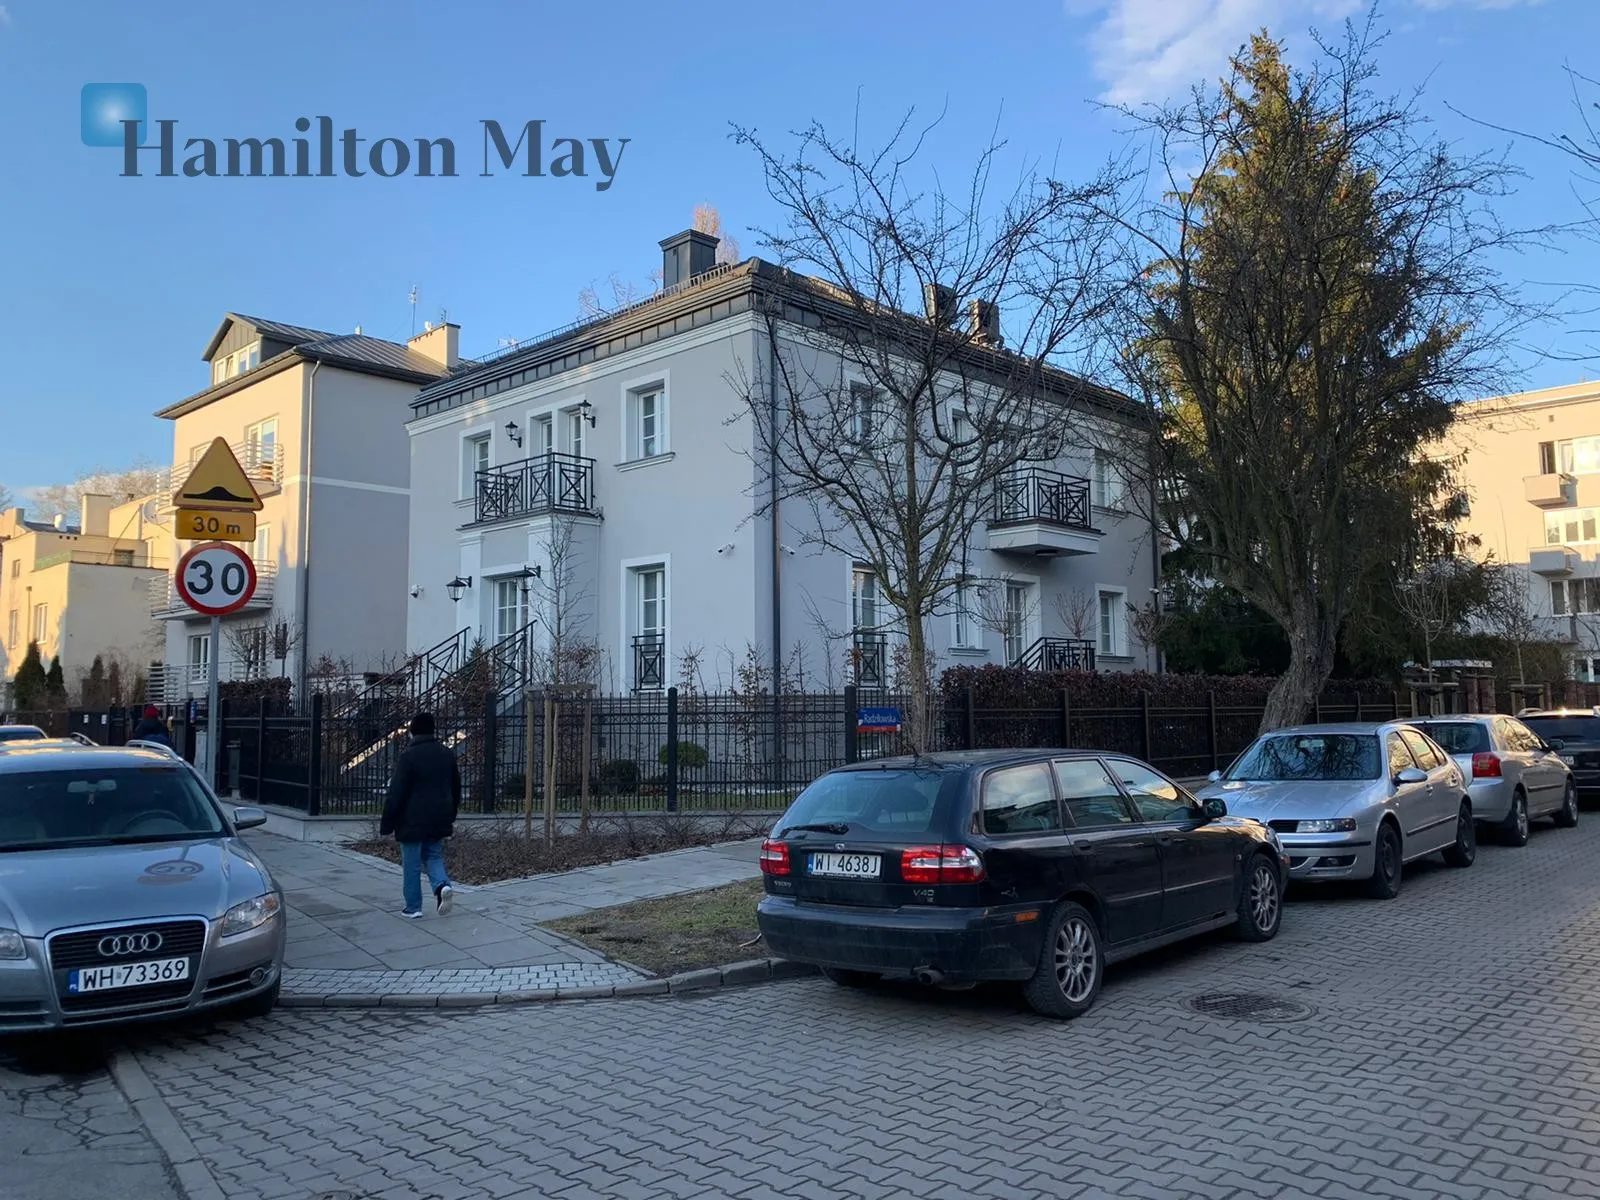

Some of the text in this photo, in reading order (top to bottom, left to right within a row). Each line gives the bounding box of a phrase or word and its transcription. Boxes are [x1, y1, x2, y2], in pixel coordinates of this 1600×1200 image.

[192, 516, 241, 534] 30 m
[187, 560, 245, 595] 30
[815, 854, 878, 873] WI 4638J
[83, 960, 186, 989] WH 73369
